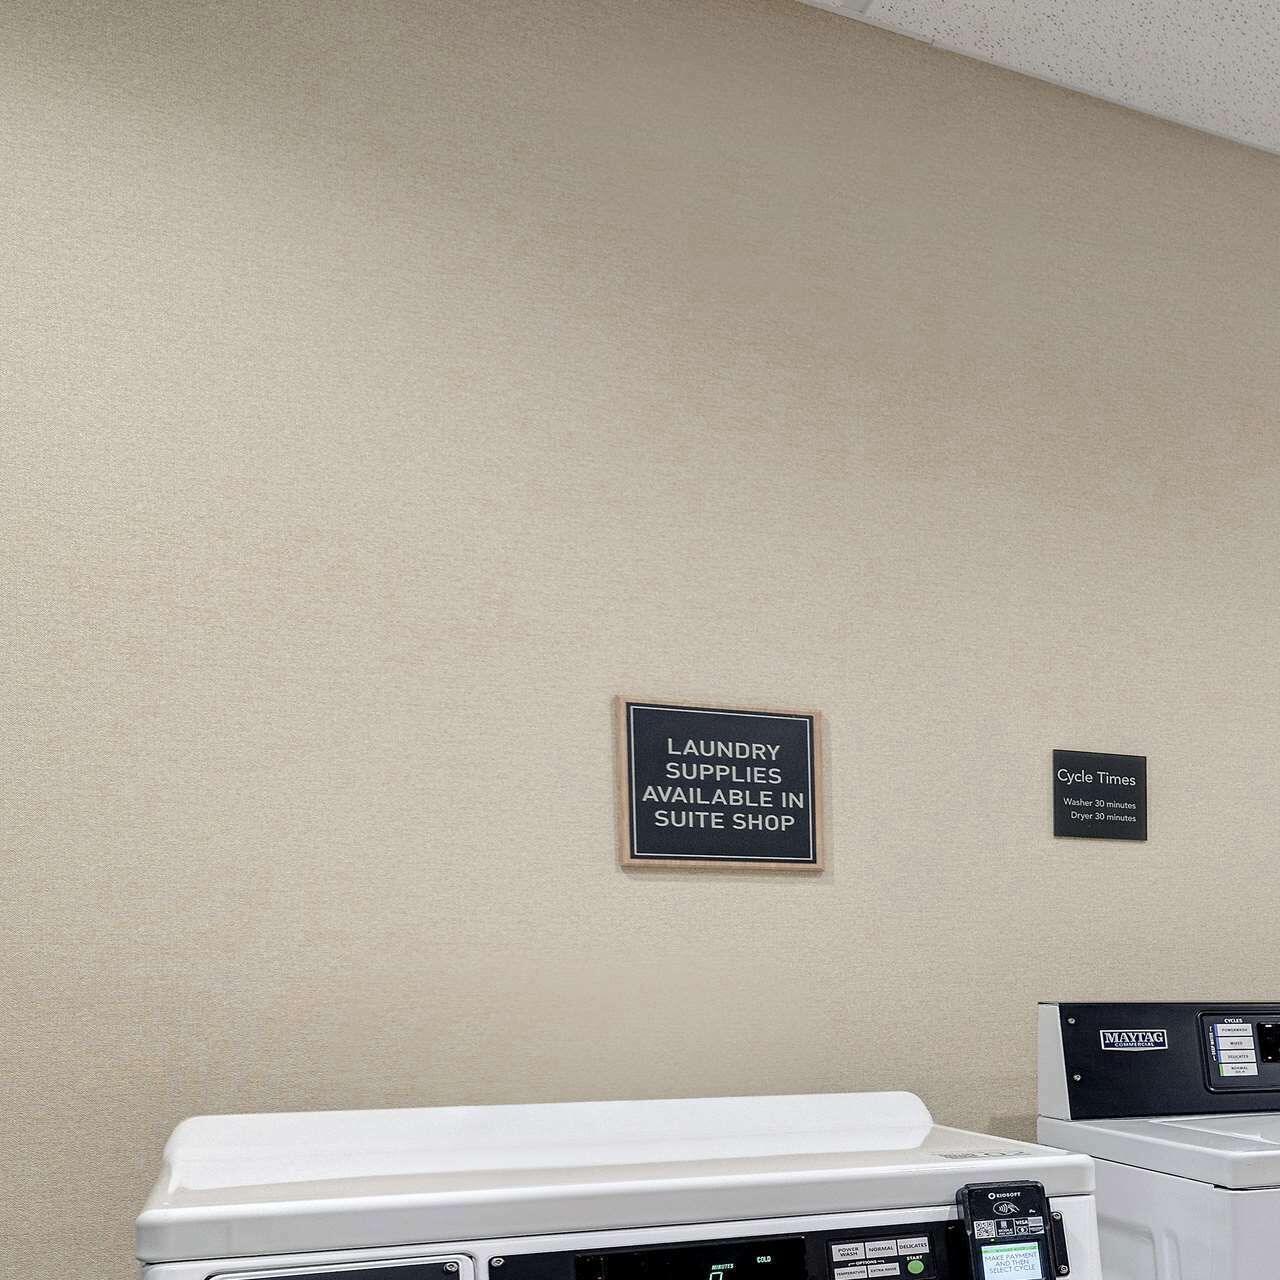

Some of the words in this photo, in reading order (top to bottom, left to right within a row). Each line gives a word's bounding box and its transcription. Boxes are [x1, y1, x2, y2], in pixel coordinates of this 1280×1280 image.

[668, 738, 780, 760] LAUNDRY
[666, 762, 782, 784] SUPPLIES
[1057, 769, 1093, 785] Cycle
[1097, 771, 1136, 786] Times
[642, 786, 773, 807] AVAILABLE
[782, 792, 803, 808] IN
[1063, 798, 1093, 806] Washer
[1095, 799, 1105, 807] 30
[1106, 800, 1136, 809] minutes
[655, 810, 724, 829] SUITE
[733, 813, 795, 831] SHOP
[1071, 811, 1093, 821] Dryer
[1095, 812, 1105, 820] 30
[1106, 813, 1136, 822] minutes
[1104, 1032, 1163, 1043] MAYTAG
[899, 1242, 928, 1250] DELICATES
[1005, 1252, 1037, 1260] PAYMENT
